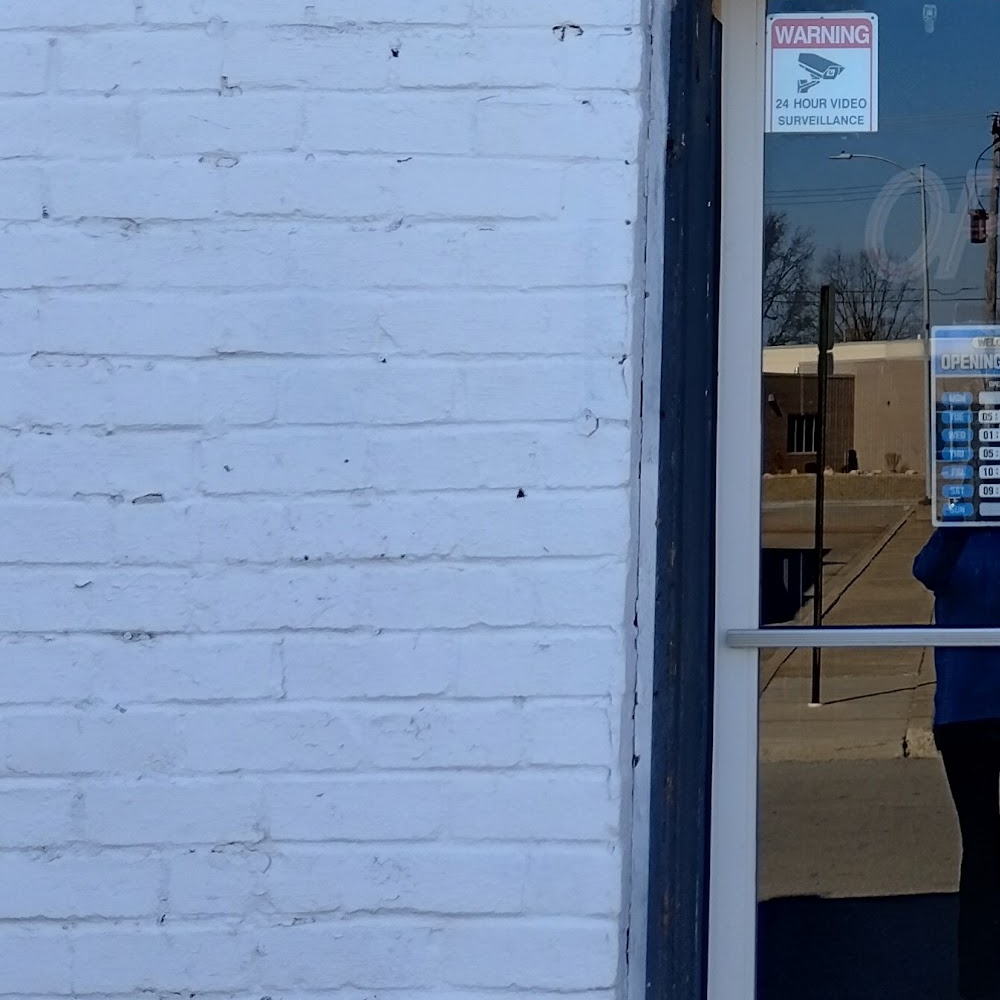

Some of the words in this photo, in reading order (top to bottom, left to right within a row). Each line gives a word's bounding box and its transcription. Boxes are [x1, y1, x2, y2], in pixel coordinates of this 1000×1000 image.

[774, 24, 870, 44] WARNING
[775, 98, 789, 109] 24
[793, 98, 827, 109] HOUR
[830, 97, 867, 109] VIDEO
[777, 115, 865, 126] SURVEILLANCE
